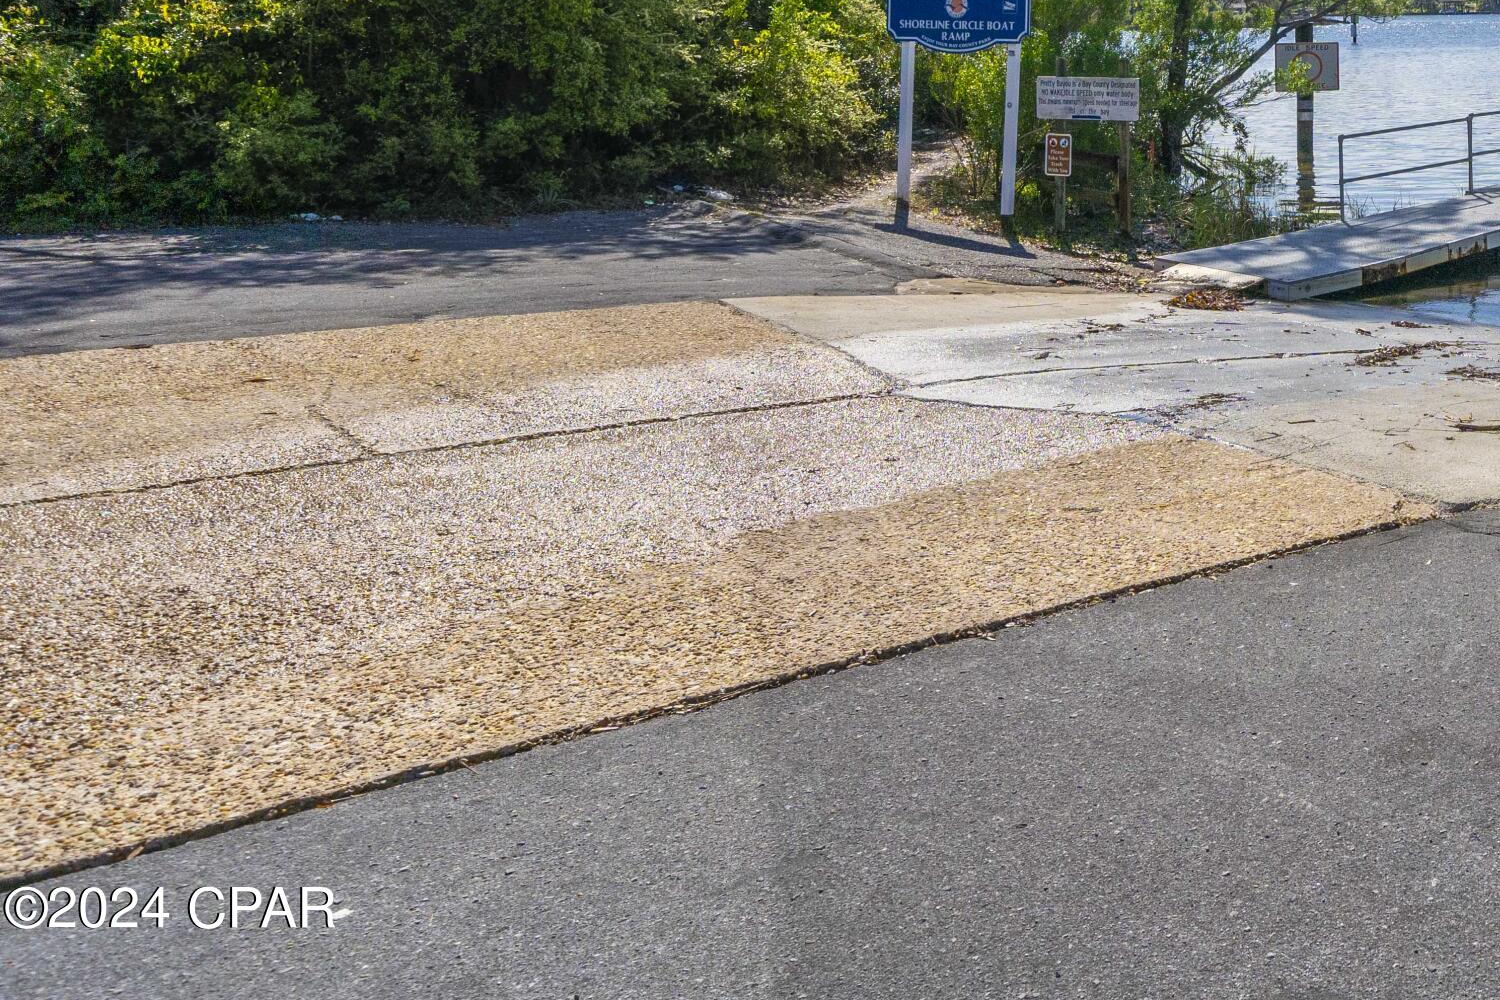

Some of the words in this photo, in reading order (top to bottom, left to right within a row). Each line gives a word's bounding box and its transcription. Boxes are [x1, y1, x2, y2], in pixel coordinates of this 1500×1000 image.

[900, 19, 949, 29] SHORELINE
[953, 20, 984, 30] CIRCLE
[987, 21, 1015, 30] BOAT
[942, 32, 970, 40] RAMP
